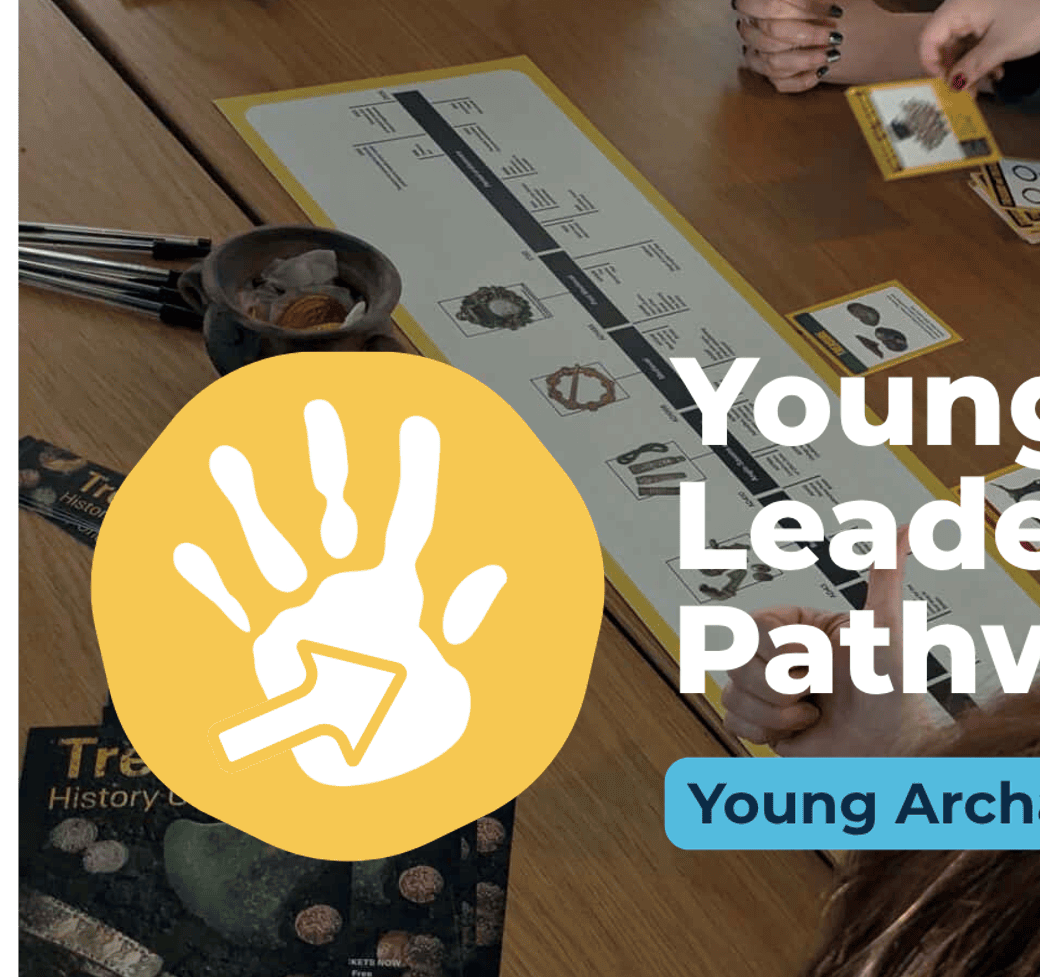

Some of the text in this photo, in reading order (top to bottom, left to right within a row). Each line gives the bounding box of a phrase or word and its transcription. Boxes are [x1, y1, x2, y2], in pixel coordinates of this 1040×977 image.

[79, 470, 117, 504] Tr
[48, 786, 161, 813] History
[377, 958, 401, 967] NOW
